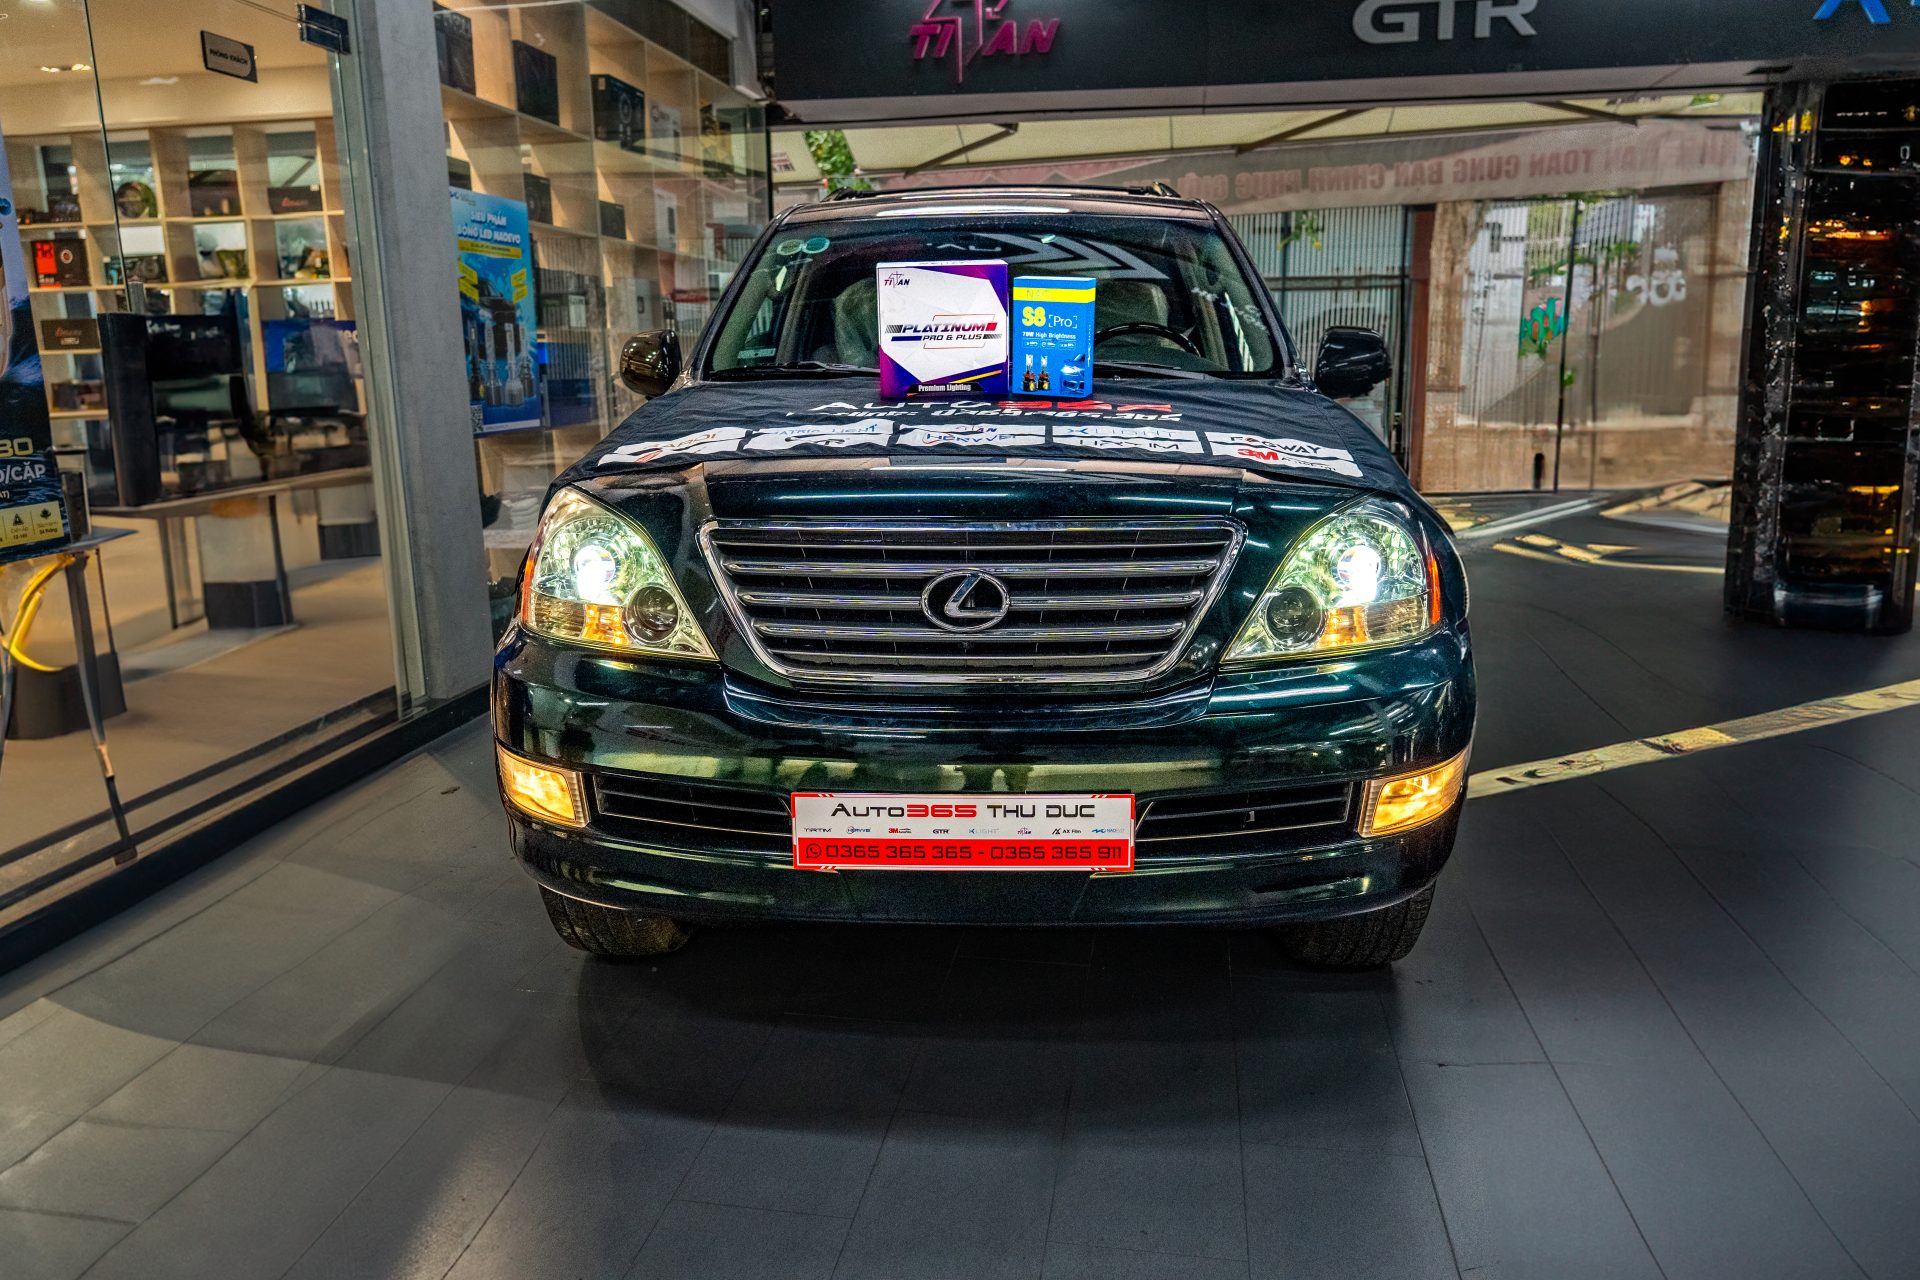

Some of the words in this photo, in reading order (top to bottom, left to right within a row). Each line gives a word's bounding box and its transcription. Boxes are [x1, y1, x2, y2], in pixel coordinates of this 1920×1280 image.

[1352, 0, 1537, 44] GTR
[910, 0, 1060, 83] TITAN
[884, 271, 910, 288] TITAN
[1022, 306, 1046, 327] S8
[1053, 316, 1073, 327] Pro
[902, 323, 985, 333] PLATINUM
[1049, 332, 1076, 340] Brightness
[918, 384, 946, 392] Premium
[947, 384, 971, 392] Lighting
[1237, 448, 1279, 461] 3M
[987, 805, 1035, 817] THU
[1046, 805, 1095, 817] DUC
[826, 845, 880, 859] 0365
[886, 845, 926, 859] 365
[932, 846, 971, 859] 365
[990, 846, 1045, 859] 0365
[1051, 846, 1092, 859] 365
[1098, 846, 1121, 859] 911
